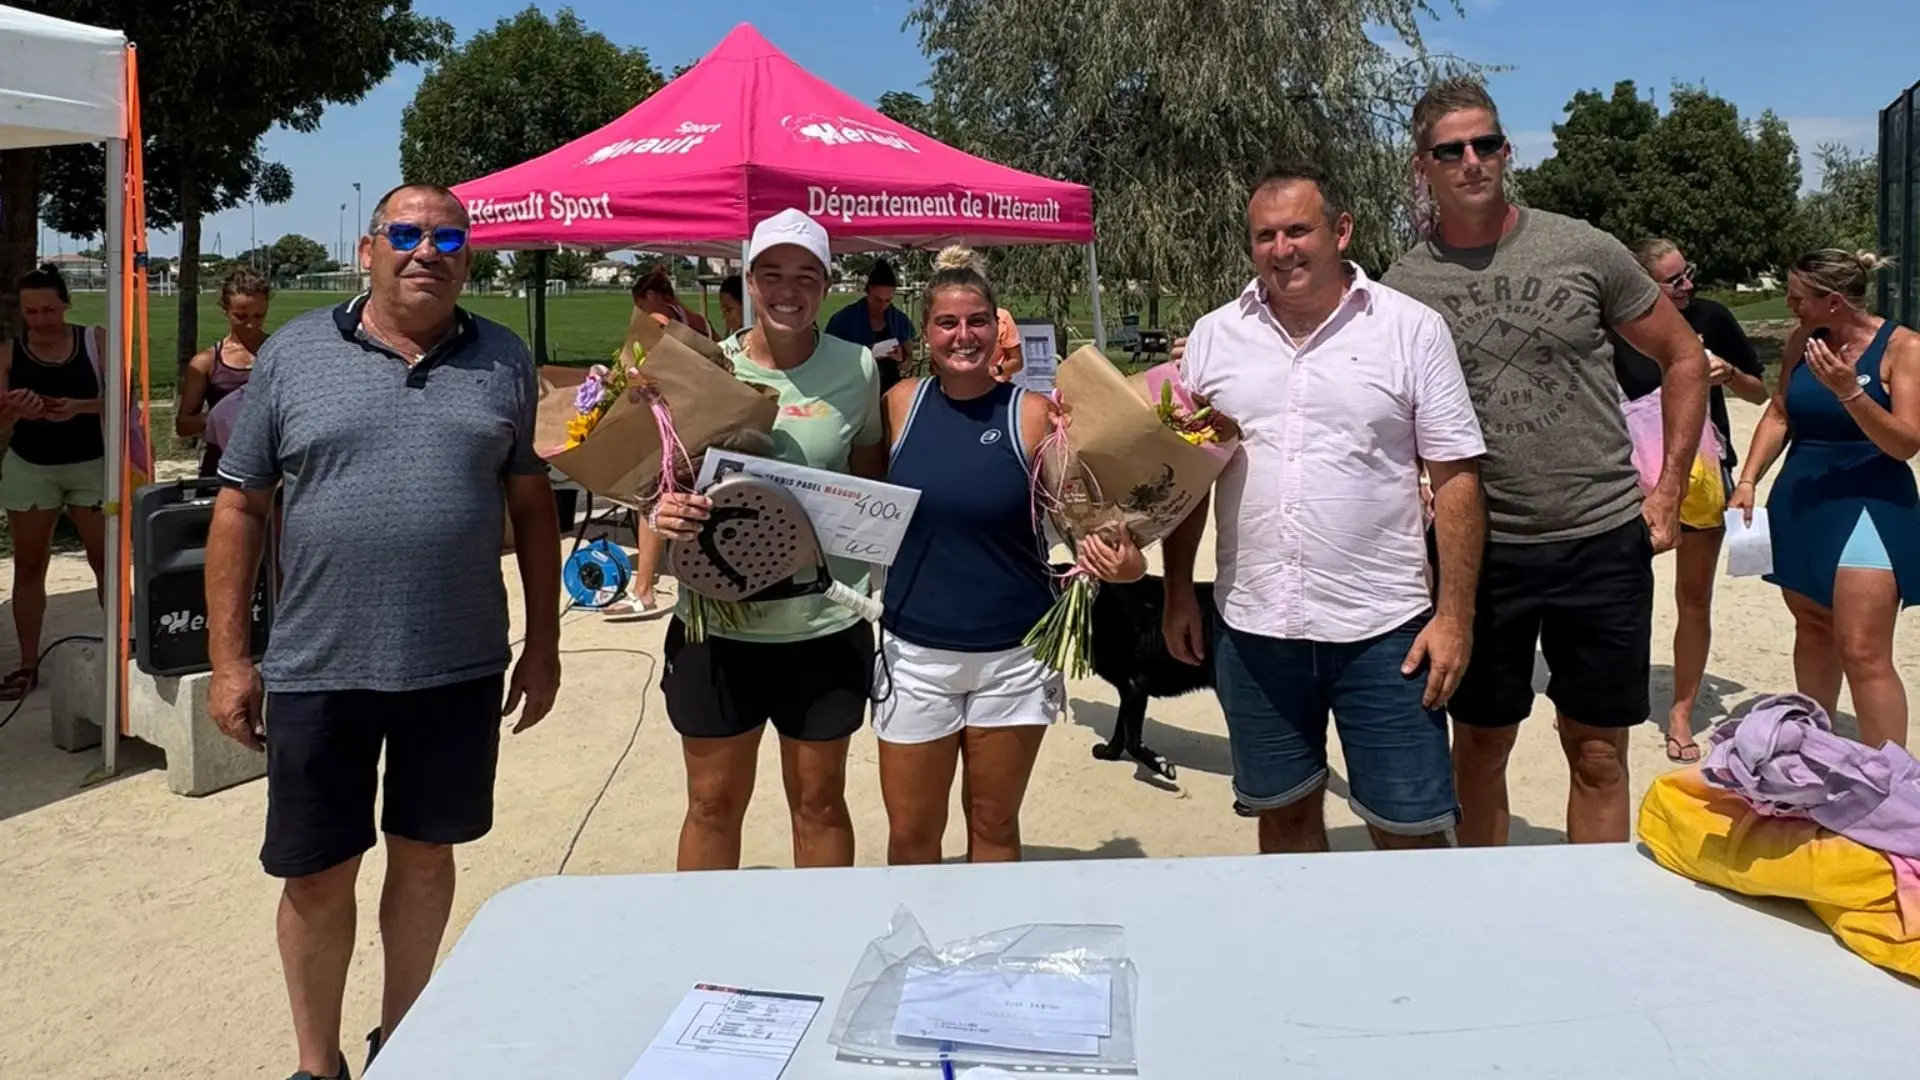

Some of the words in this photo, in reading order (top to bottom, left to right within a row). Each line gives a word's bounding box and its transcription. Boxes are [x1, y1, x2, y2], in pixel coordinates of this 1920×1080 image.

[468, 191, 544, 225] Hérault
[550, 190, 614, 227] Sport
[807, 186, 958, 223] Département
[960, 190, 983, 219] de
[987, 191, 1061, 223] l'Hérault
[1443, 275, 1592, 323] PERDRY
[1534, 344, 1554, 366] 3
[1499, 388, 1533, 406] JPN
[796, 480, 822, 493] PADEL
